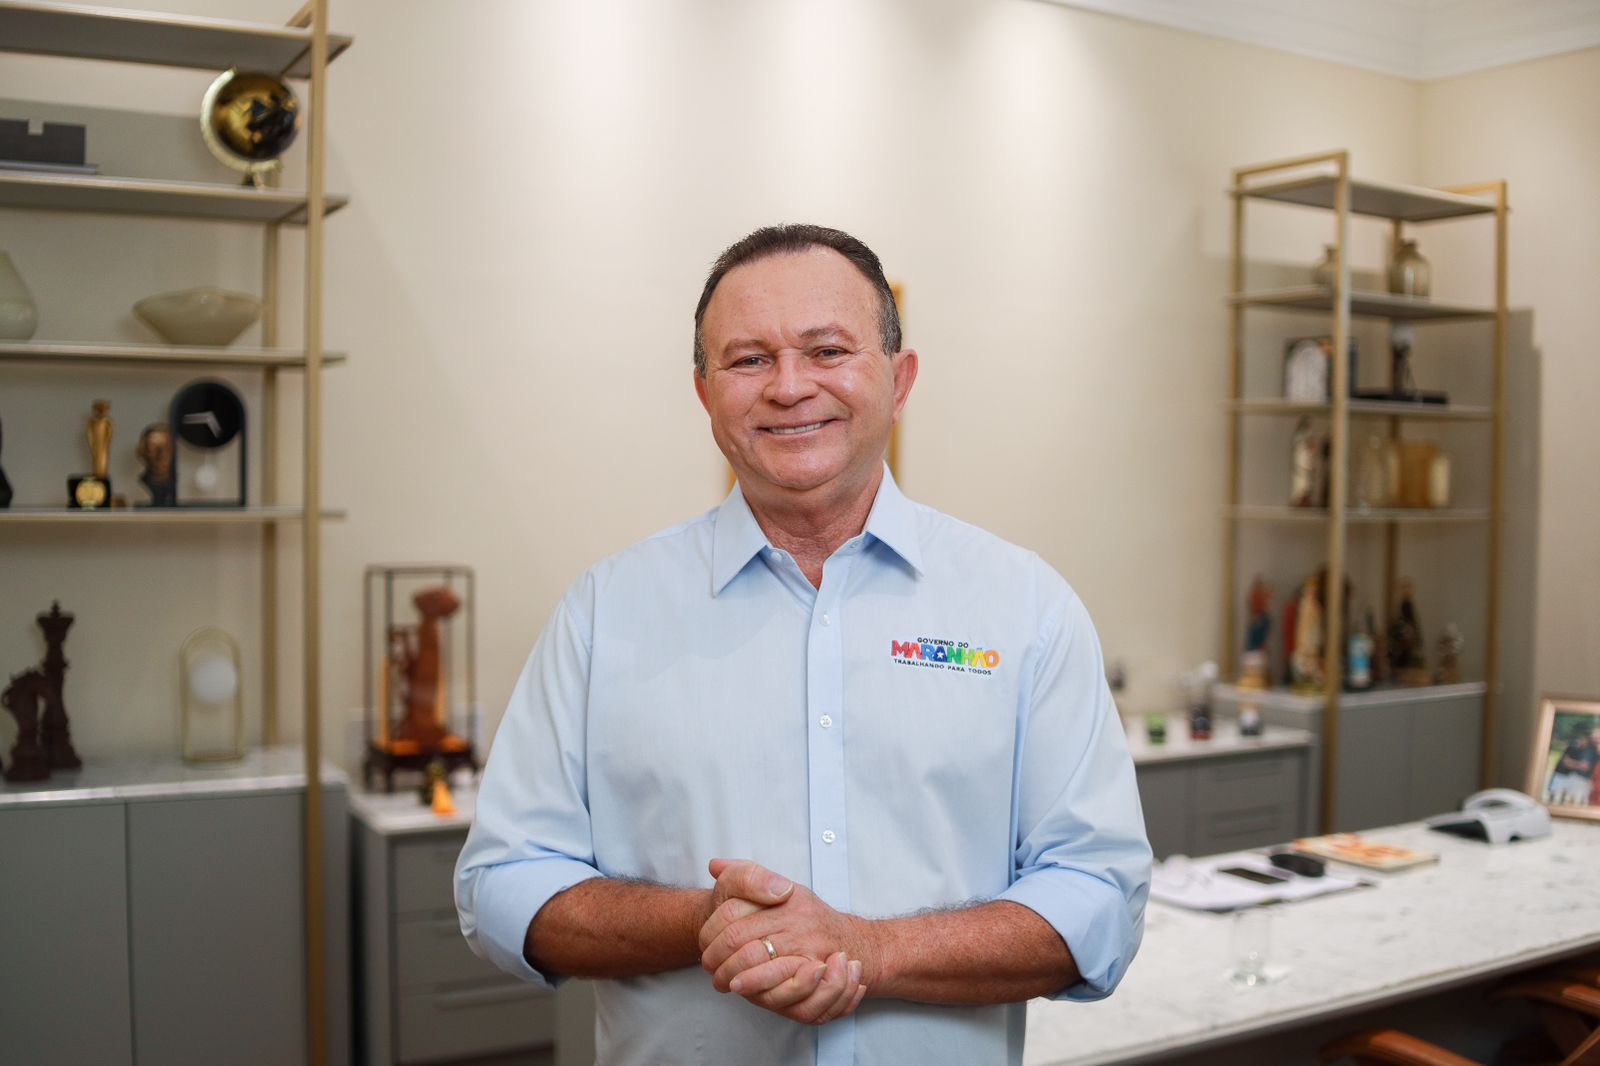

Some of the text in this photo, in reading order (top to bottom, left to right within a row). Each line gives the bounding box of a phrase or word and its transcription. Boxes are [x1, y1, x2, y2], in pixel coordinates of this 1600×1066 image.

[917, 637, 954, 647] GOVERNO
[891, 640, 1000, 669] MARANHÃO
[894, 658, 945, 669] TRABALHANDO
[968, 668, 992, 676] TODOS
